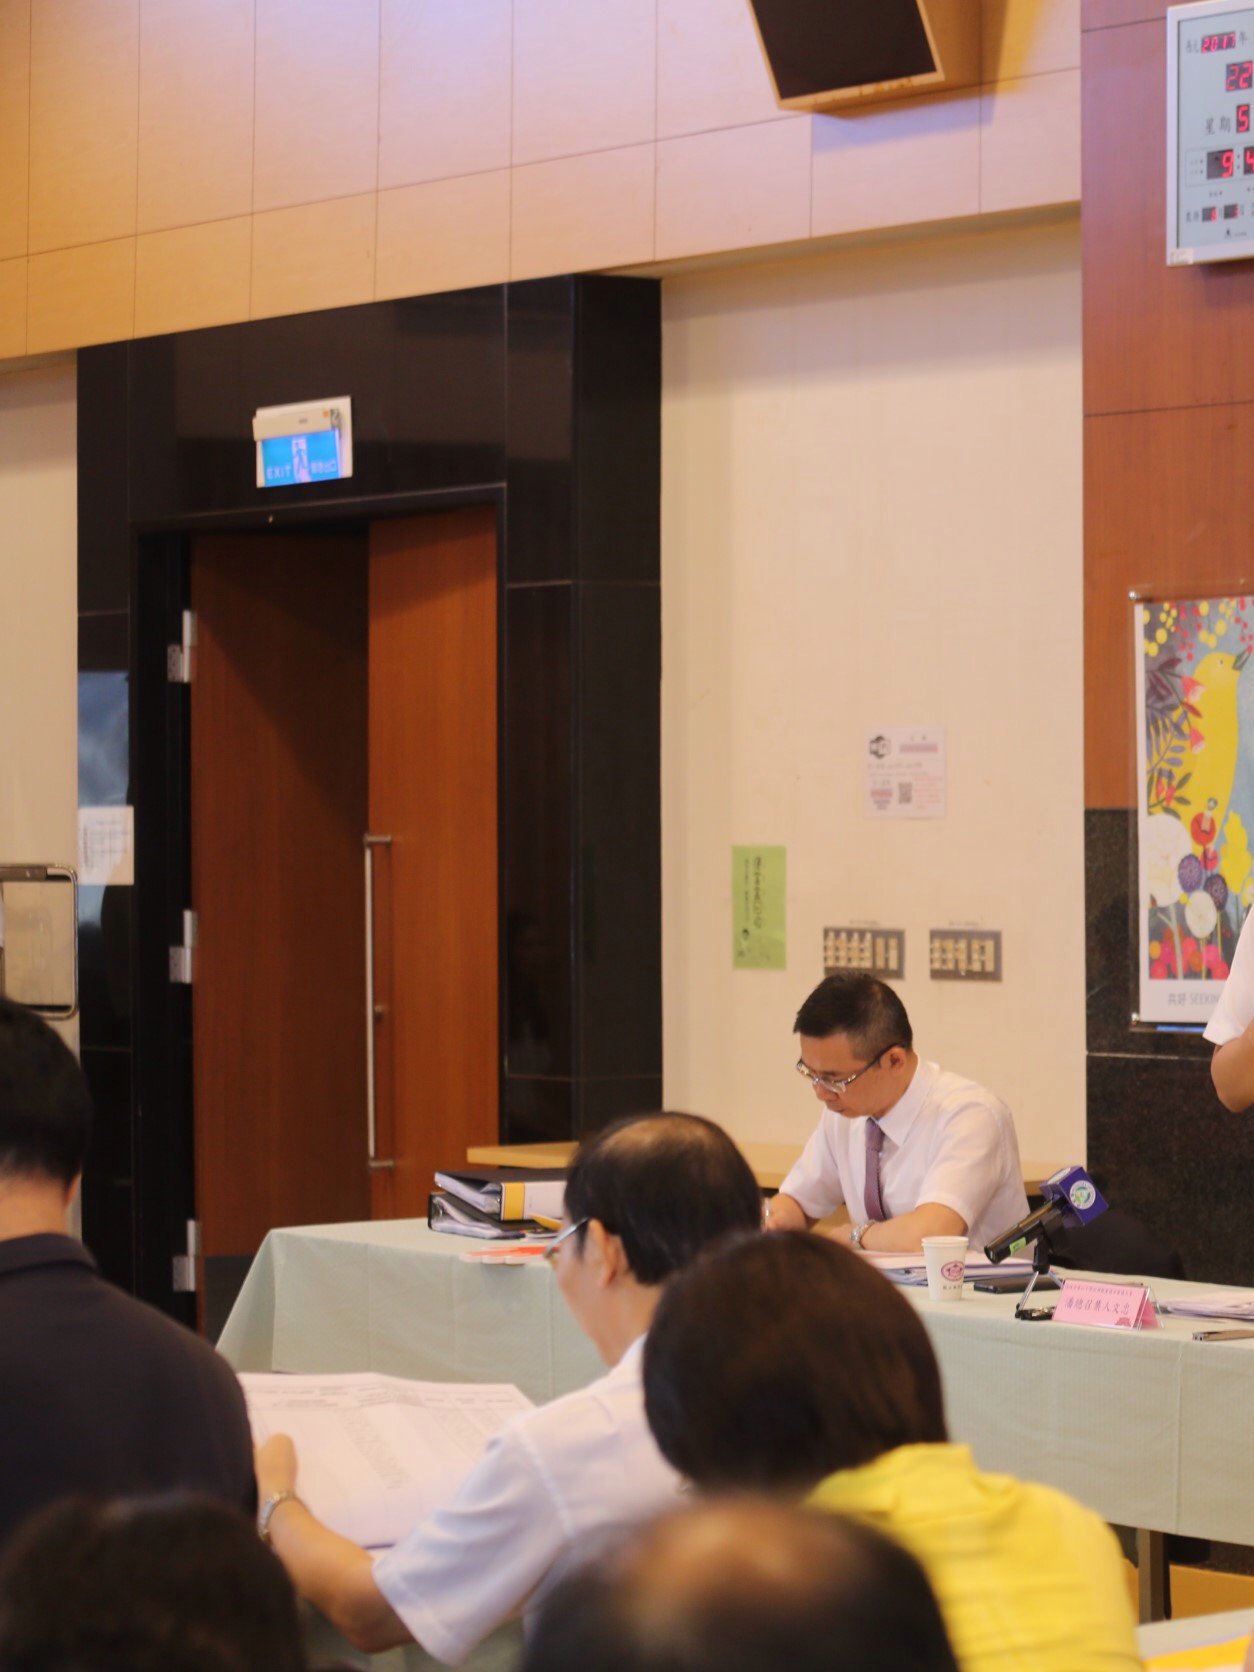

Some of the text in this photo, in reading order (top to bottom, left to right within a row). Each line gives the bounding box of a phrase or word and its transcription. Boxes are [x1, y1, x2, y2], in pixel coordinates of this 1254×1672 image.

[1201, 31, 1236, 53] 2017
[1226, 61, 1253, 91] 22
[1205, 104, 1250, 134] 星期 5
[266, 463, 292, 480] EXIT
[1190, 993, 1220, 1005] SEEKIN
